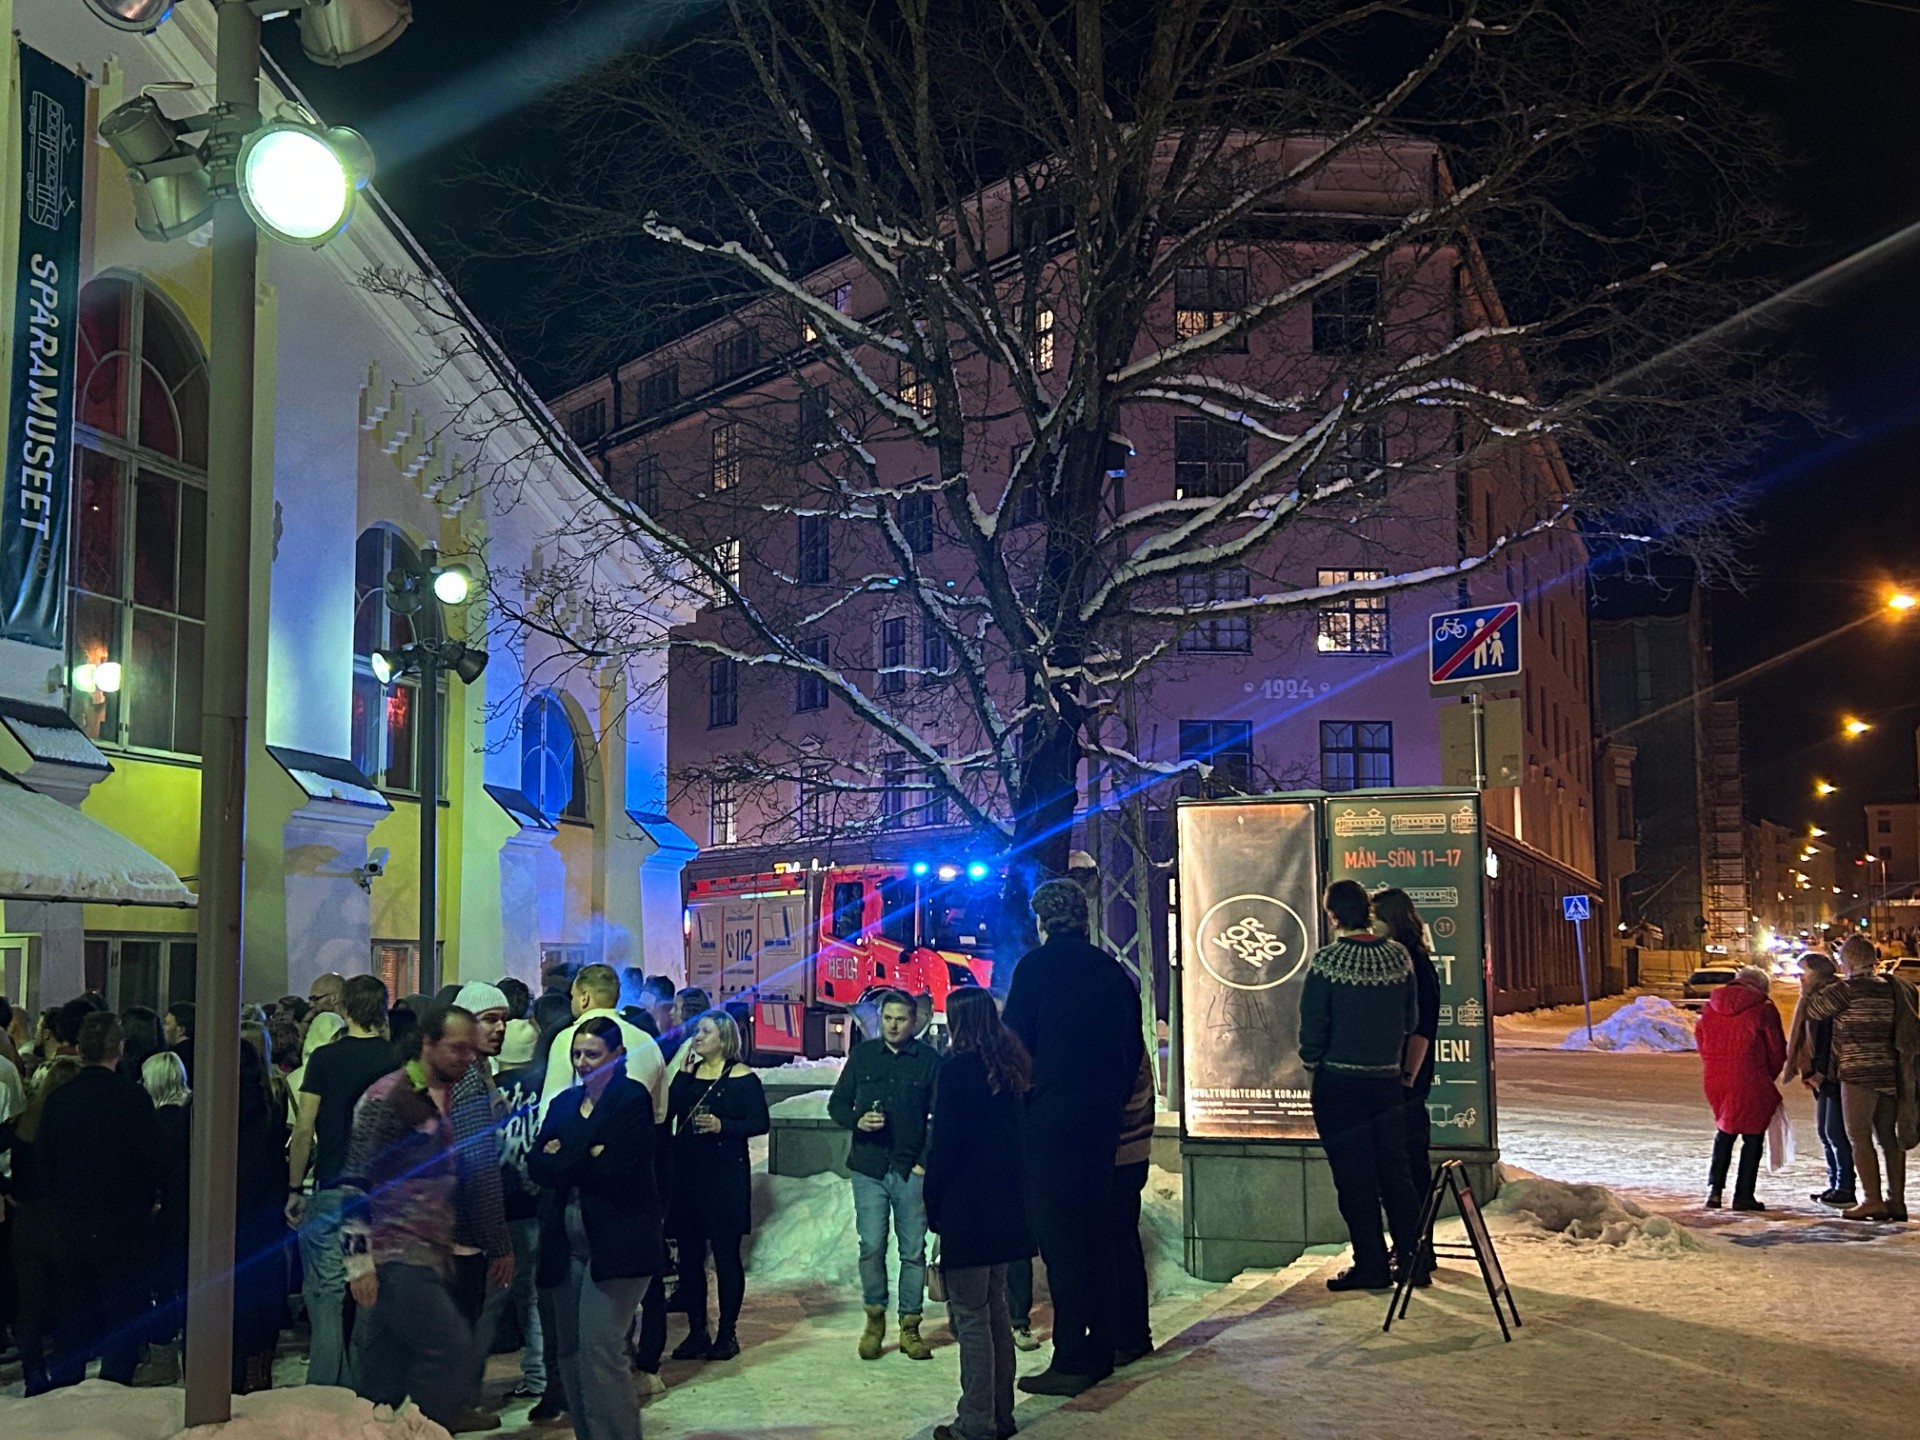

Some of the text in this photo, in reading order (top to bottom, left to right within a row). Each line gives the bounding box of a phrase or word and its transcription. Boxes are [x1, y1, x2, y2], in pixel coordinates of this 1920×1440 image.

[20, 252, 60, 541] SPÅRAMUSEET
[1260, 678, 1315, 699] 1924
[735, 928, 753, 962] 112
[1274, 1088, 1311, 1099] KORJAA
